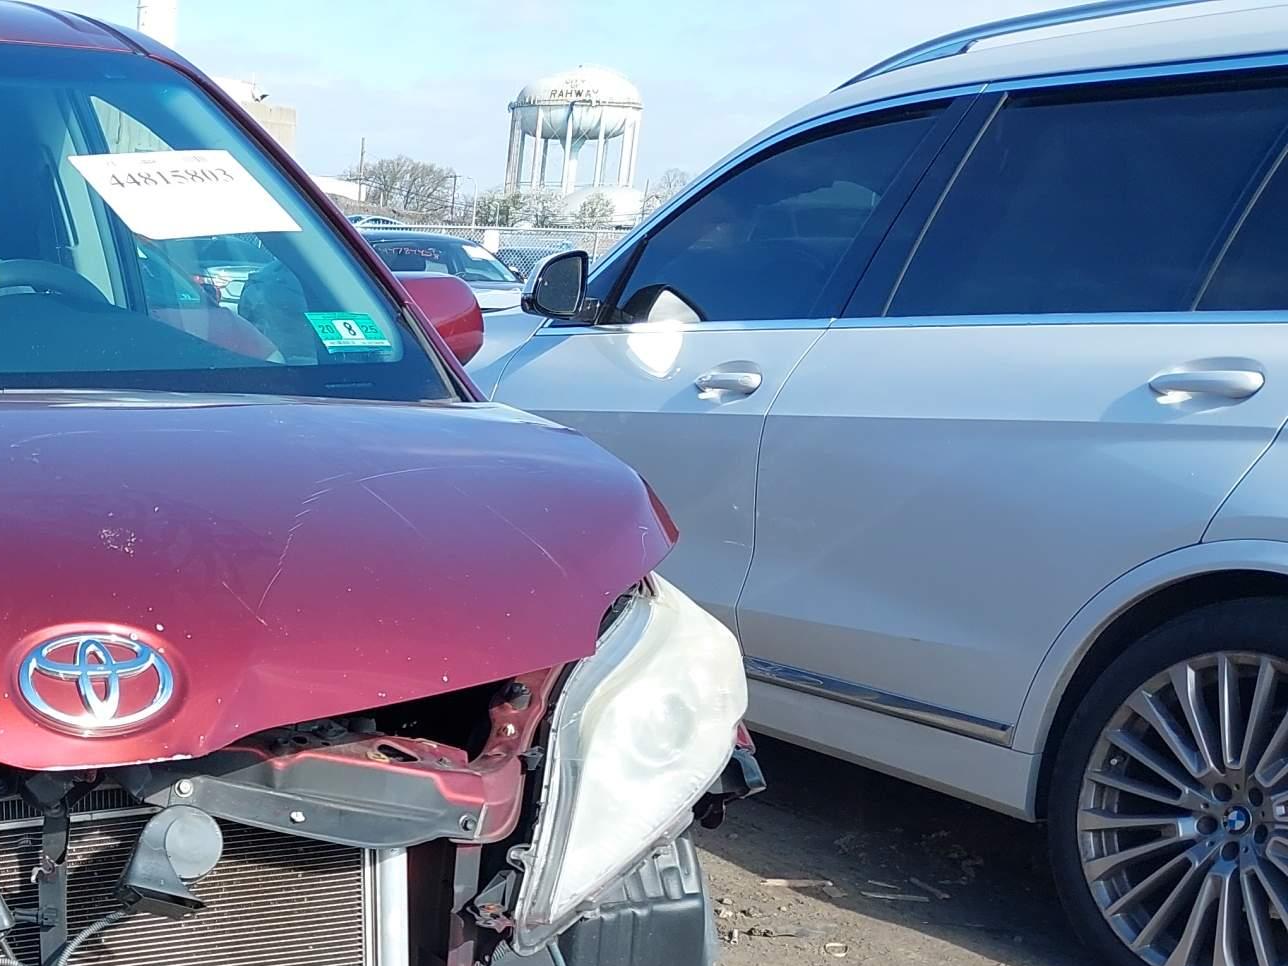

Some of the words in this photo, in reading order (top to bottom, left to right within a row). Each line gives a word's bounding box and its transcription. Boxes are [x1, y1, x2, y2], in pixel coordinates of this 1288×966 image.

[549, 88, 600, 99] RAHWAY
[111, 167, 234, 188] 44815803
[318, 324, 335, 334] 20
[343, 321, 357, 336] 8
[361, 324, 378, 334] 25
